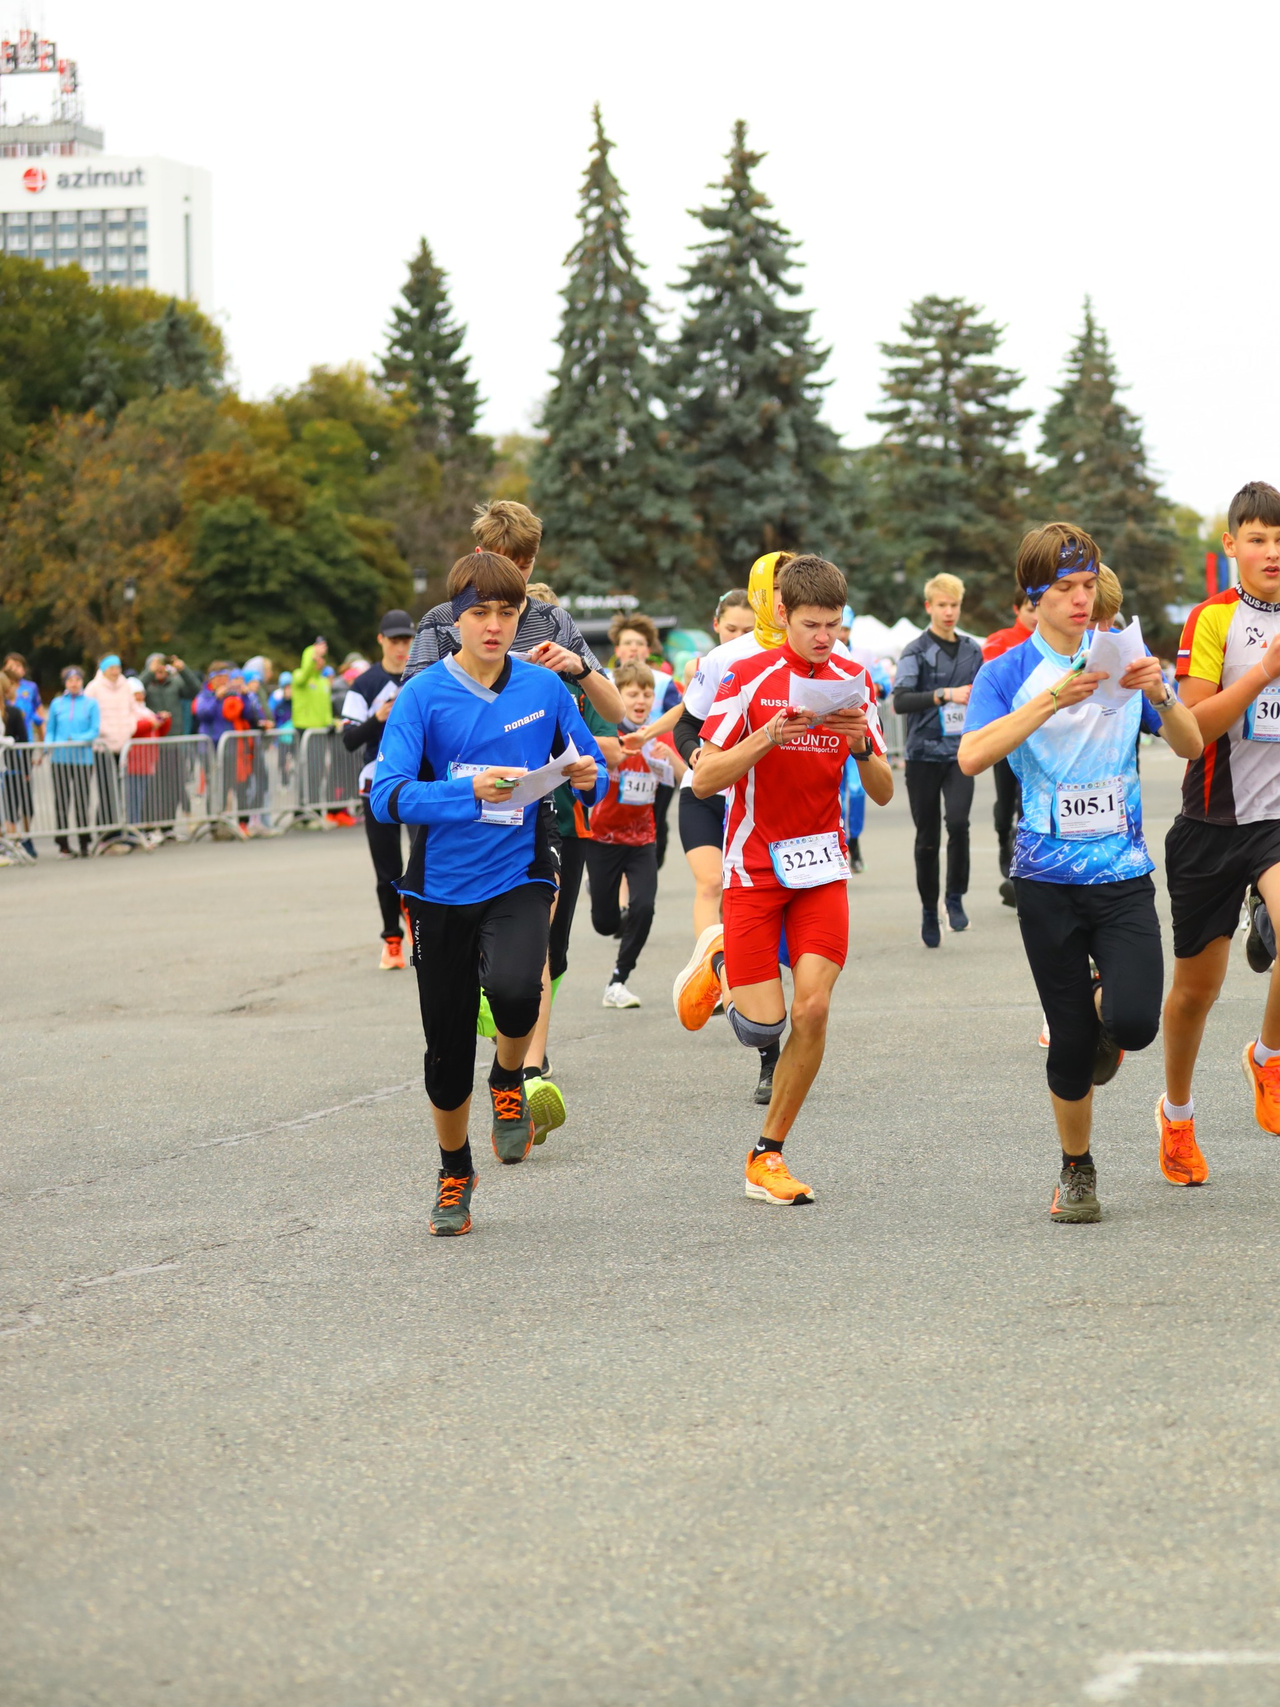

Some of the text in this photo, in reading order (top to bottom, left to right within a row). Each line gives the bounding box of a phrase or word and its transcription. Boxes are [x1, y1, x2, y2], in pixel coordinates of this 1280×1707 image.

[57, 166, 146, 189] azimut
[503, 709, 546, 733] noname
[780, 744, 839, 754] www.watchsport.ru
[787, 734, 840, 748] UUNTO
[625, 780, 655, 792] 341.1
[1060, 794, 1115, 817] 305.1
[782, 847, 832, 872] 322.1
